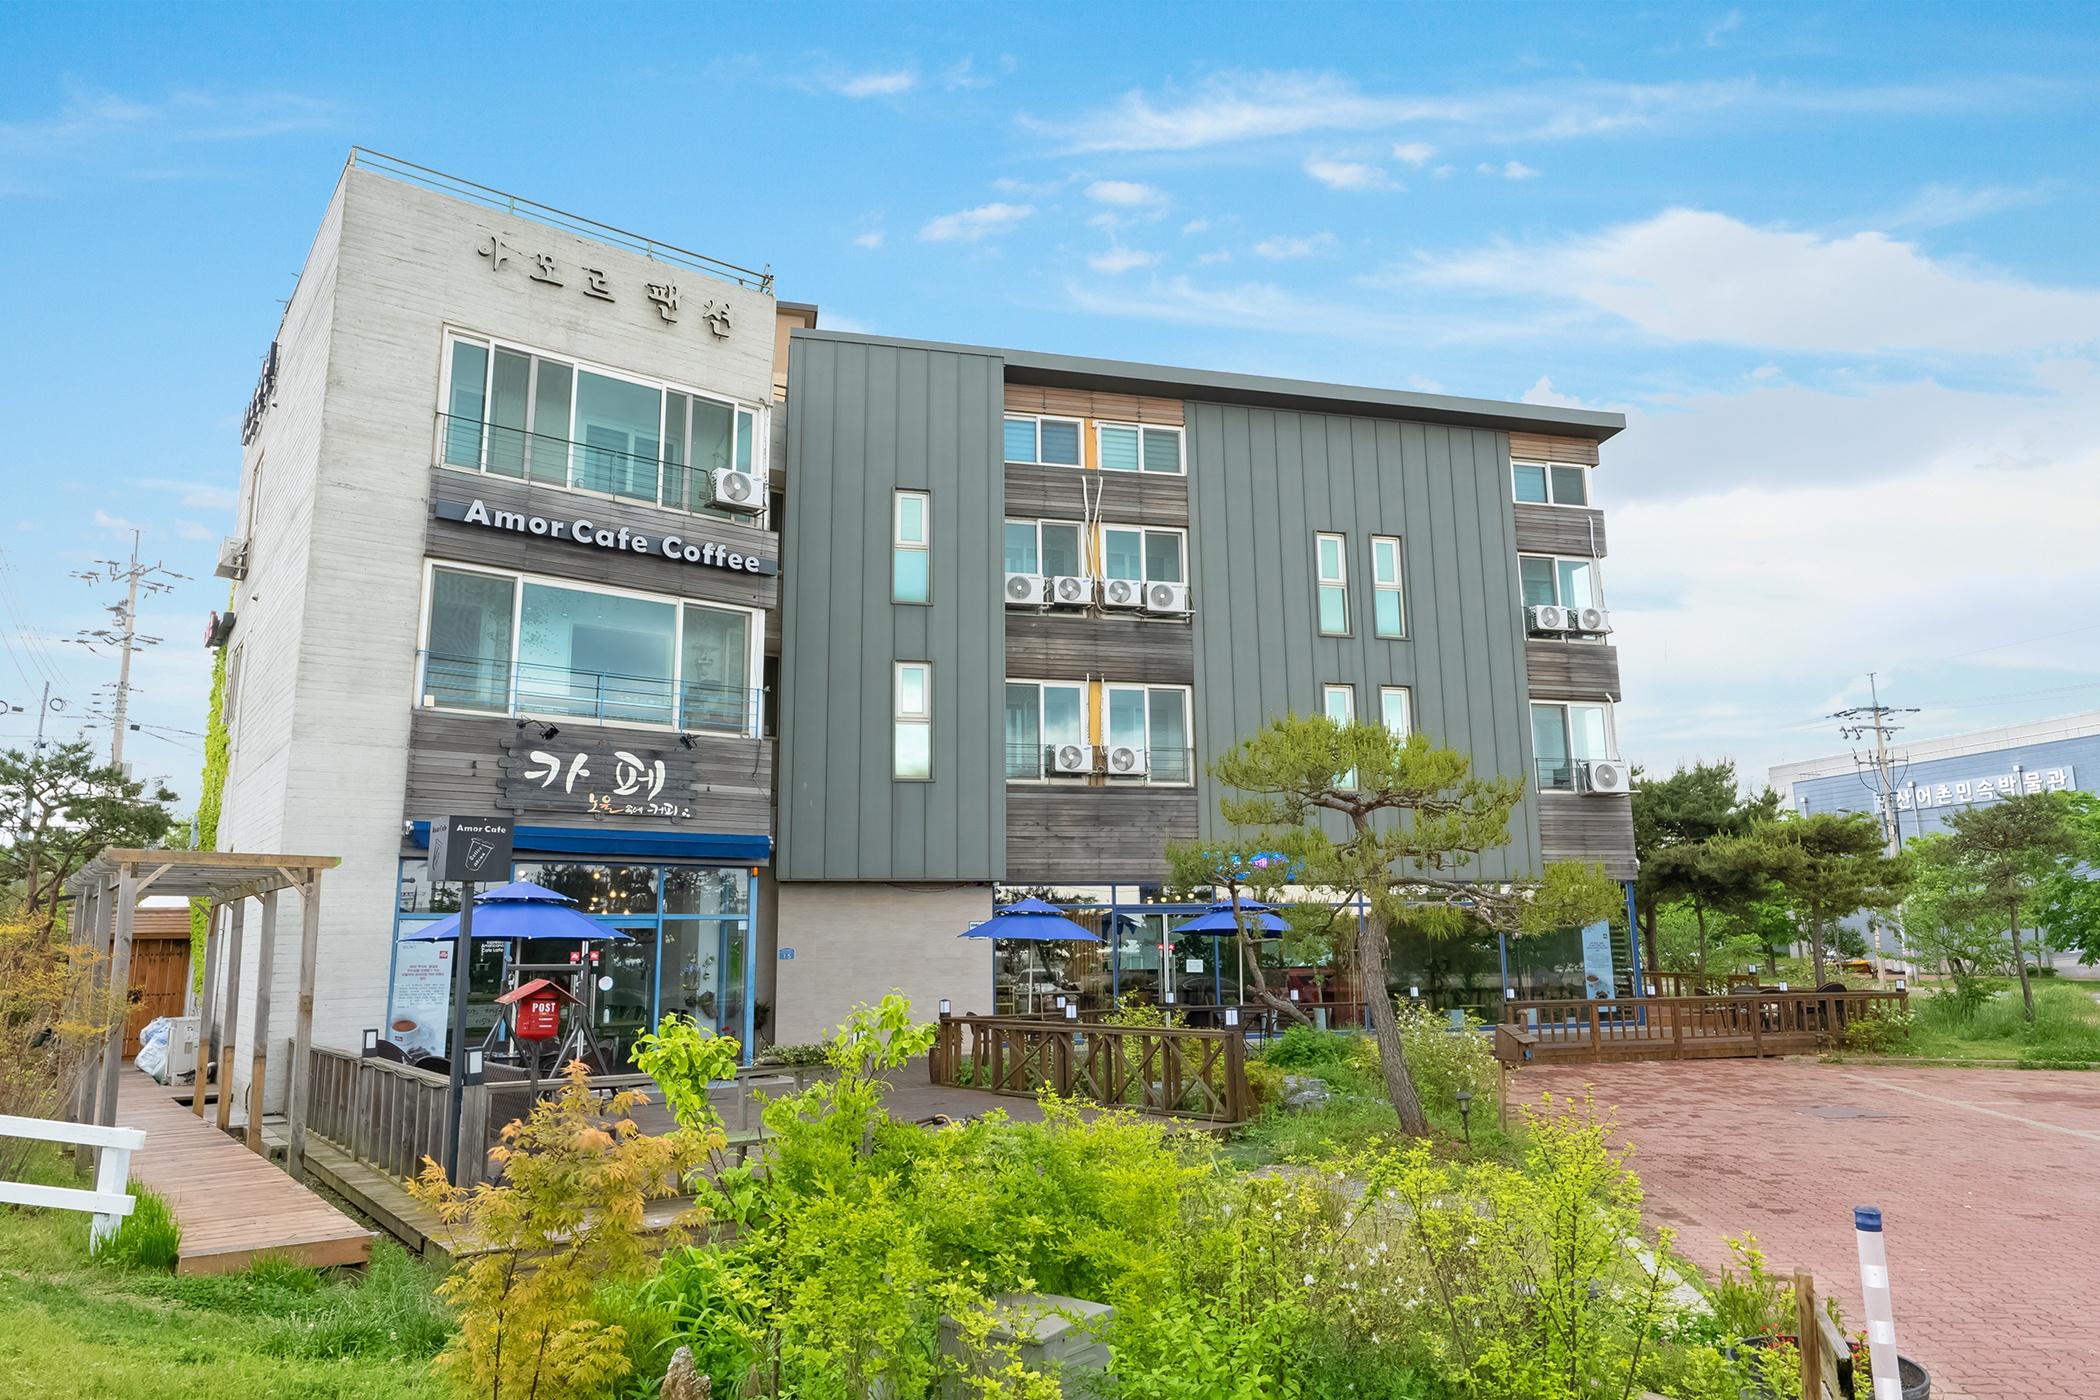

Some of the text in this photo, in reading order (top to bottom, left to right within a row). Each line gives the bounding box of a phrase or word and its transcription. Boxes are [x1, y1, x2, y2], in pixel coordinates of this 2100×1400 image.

[477, 235, 616, 304] 아모르
[463, 498, 760, 573] Amor Cafe Coffee
[523, 750, 667, 801] 카페
[1875, 767, 2069, 810] 산어촌민속박물관
[456, 824, 483, 833] Amor
[484, 825, 507, 834] Cafe
[531, 1002, 556, 1013] POST
